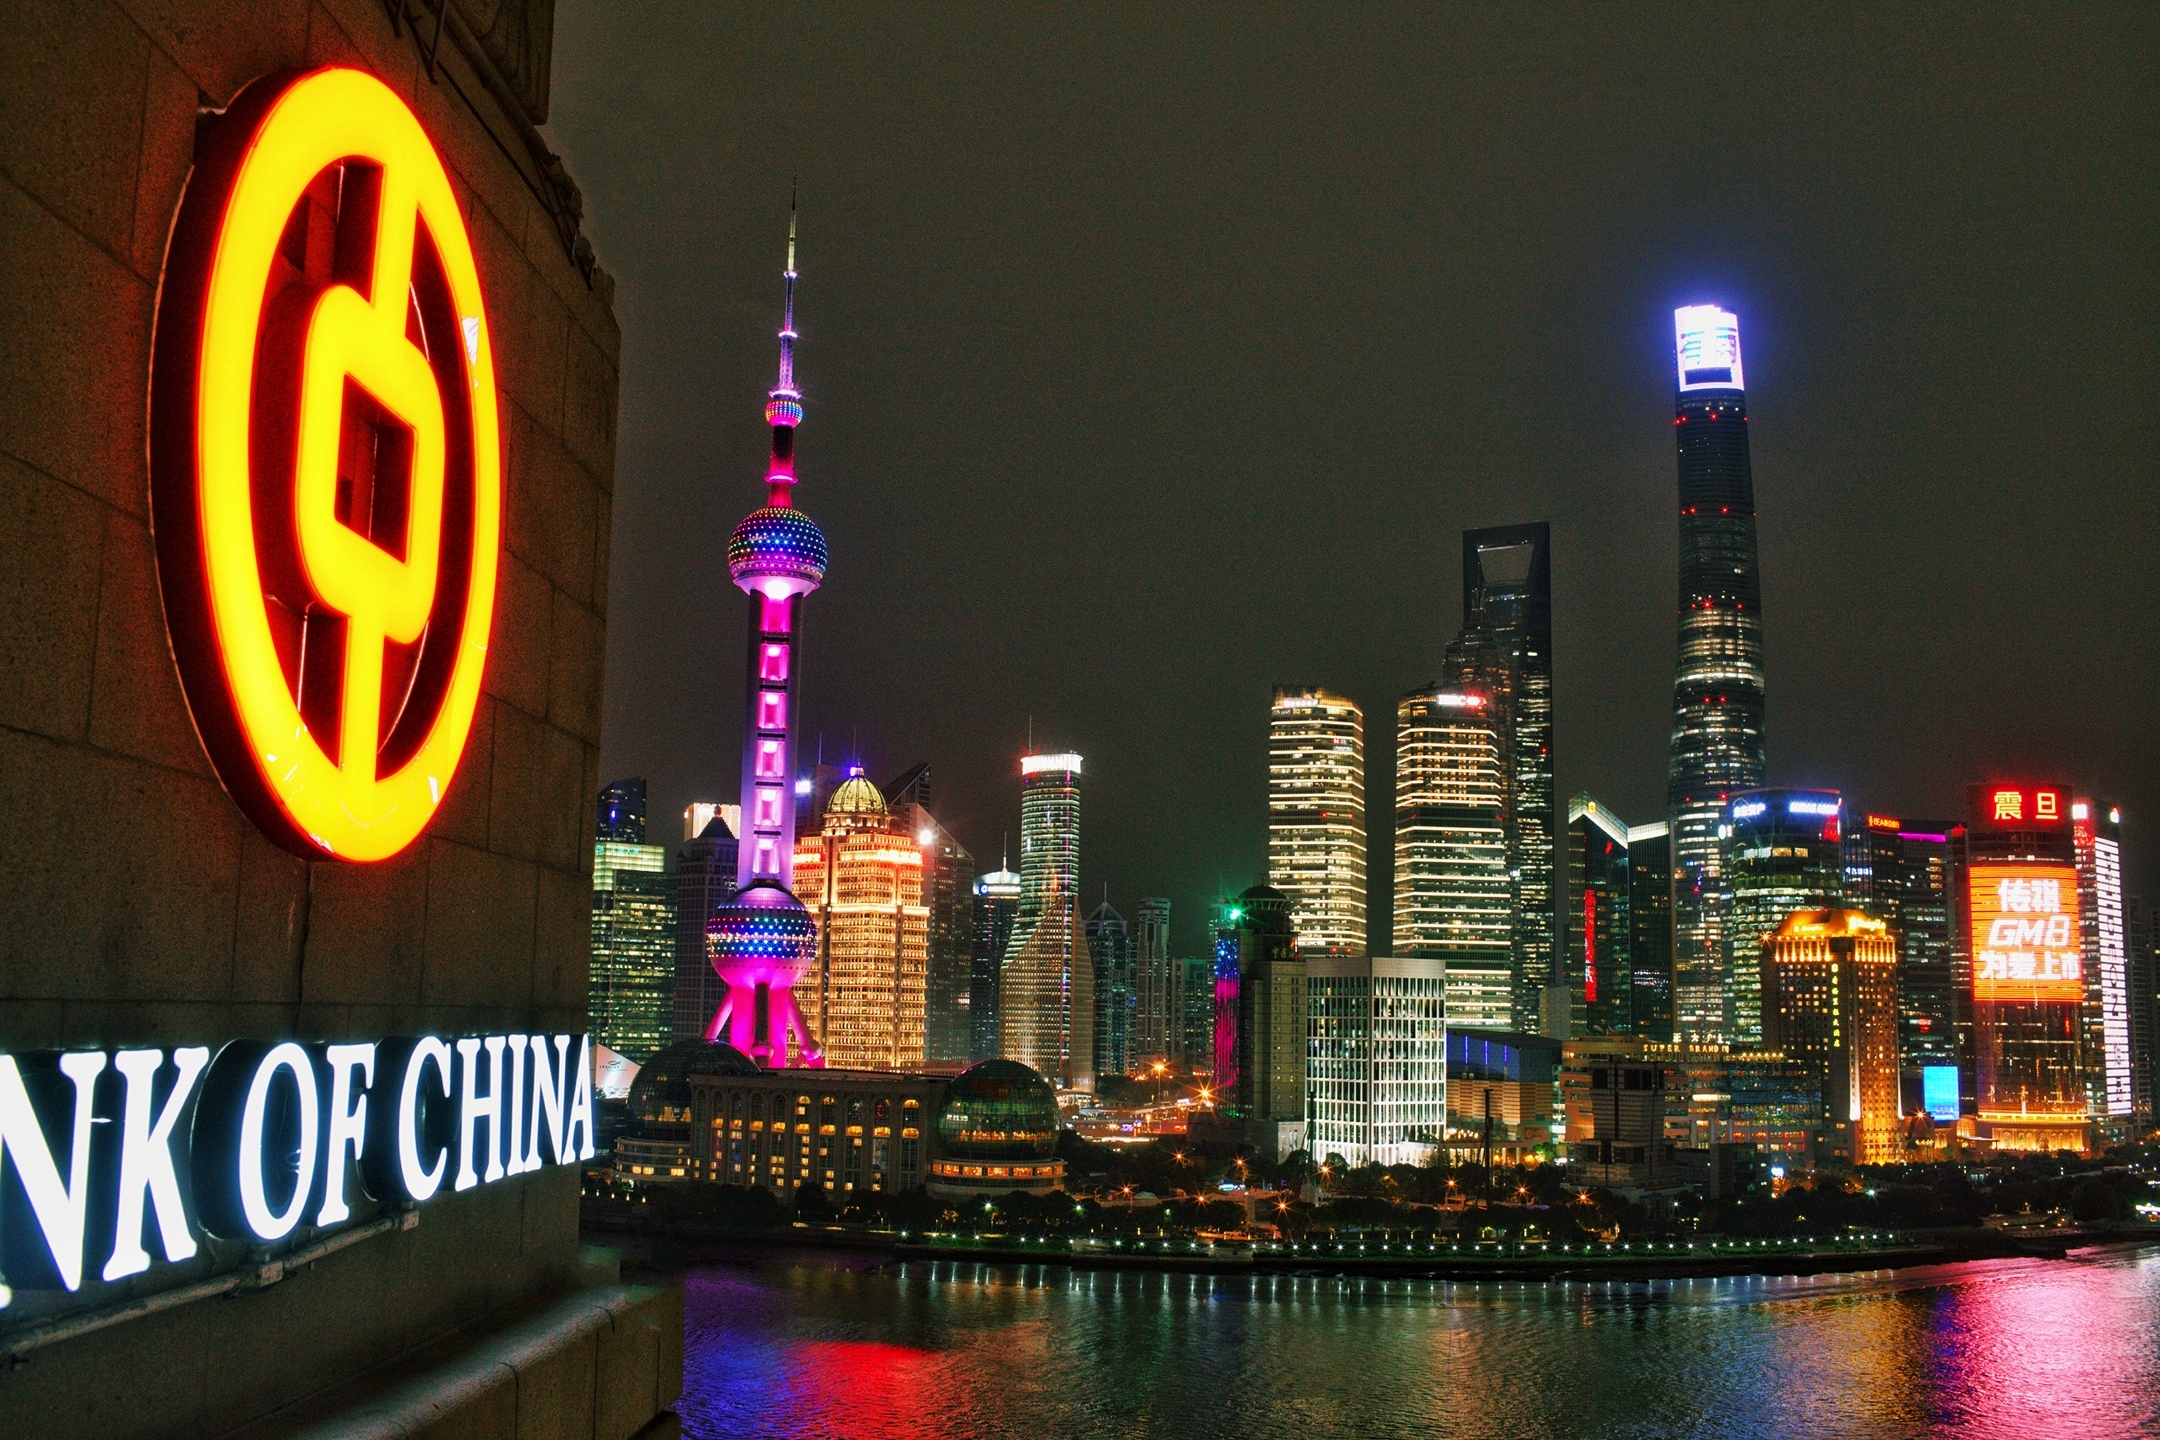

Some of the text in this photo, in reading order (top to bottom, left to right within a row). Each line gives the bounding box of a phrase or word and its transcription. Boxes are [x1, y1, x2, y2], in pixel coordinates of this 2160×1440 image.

[1994, 791, 2059, 820] 震旦
[1998, 878, 2061, 913] 传祺
[1988, 915, 2070, 947] GM8
[1979, 950, 2079, 980] 为爱上市
[1643, 1044, 1681, 1053] SUPER
[1688, 1044, 1720, 1054] BRAND
[239, 1041, 375, 1241] OF
[399, 1033, 596, 1201] CHINA
